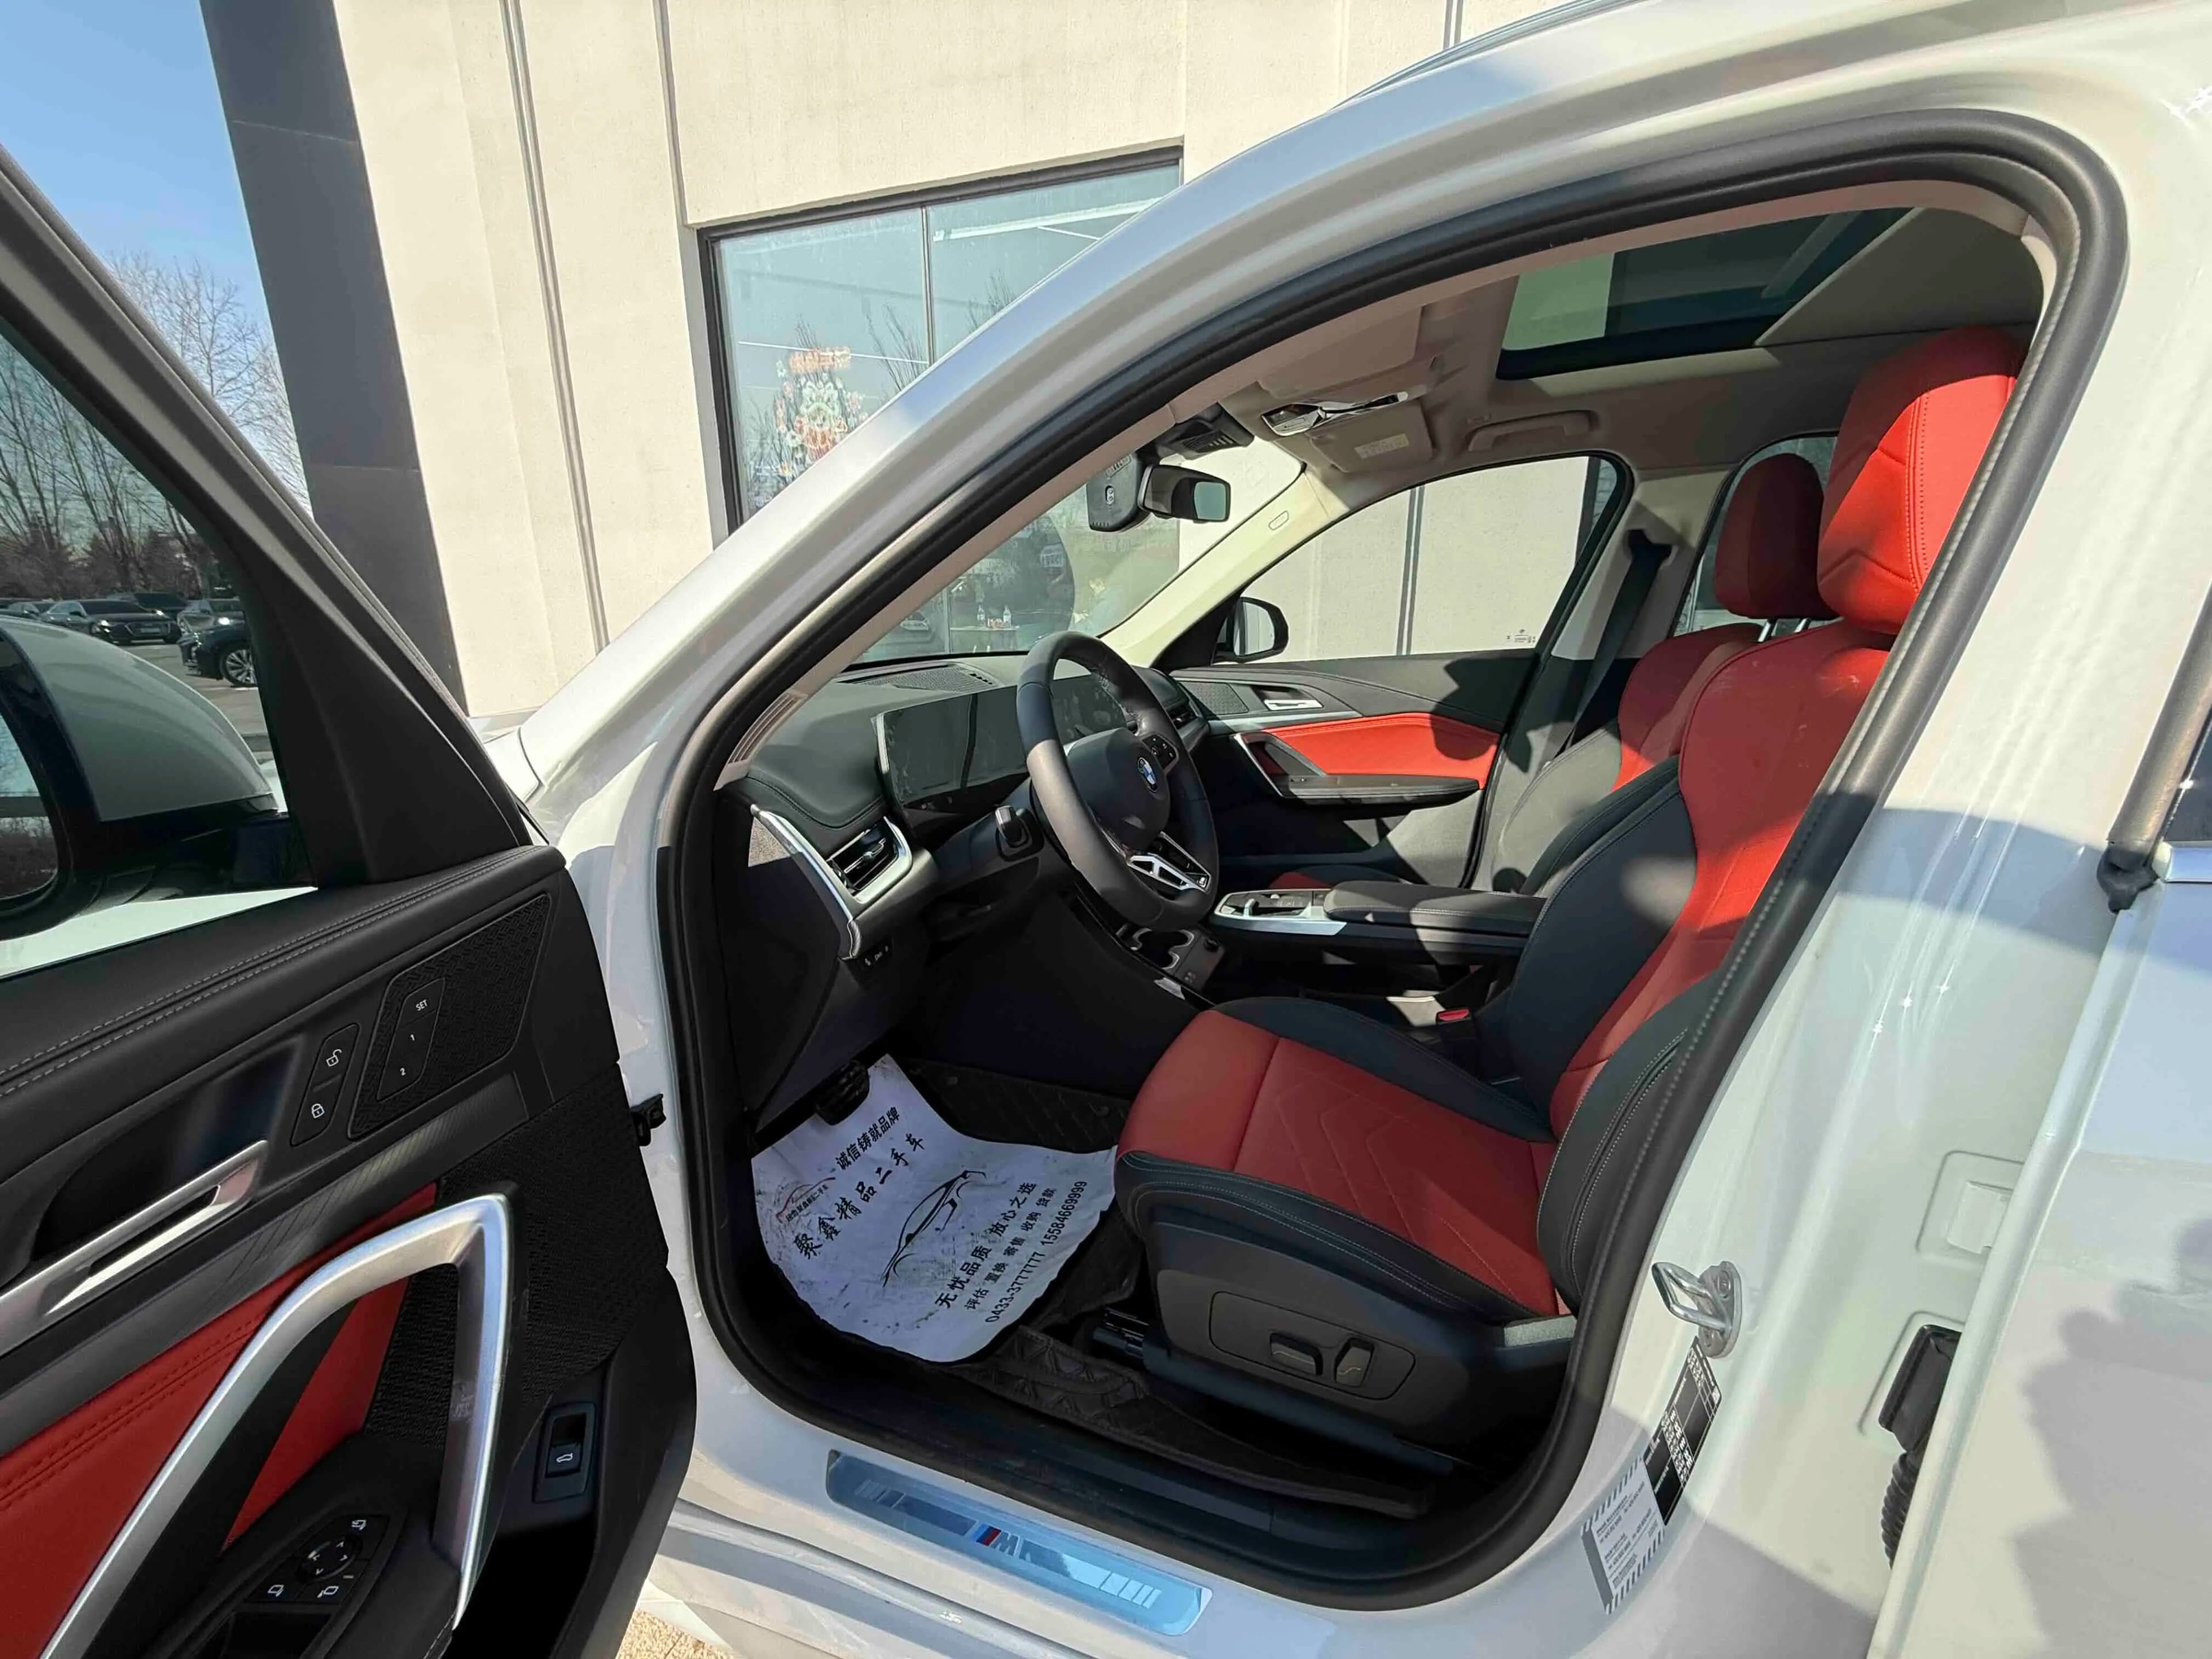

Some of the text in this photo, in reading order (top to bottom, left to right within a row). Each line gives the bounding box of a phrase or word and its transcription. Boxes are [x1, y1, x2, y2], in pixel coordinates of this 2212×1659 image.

[415, 999, 427, 1011] SET
[400, 1067, 406, 1076] 2
[793, 1133, 925, 1260] 聚鑫精品二手车
[835, 1107, 900, 1170] 诚信铸就品牌
[934, 1181, 1037, 1309] 无忧品质 放心之选
[964, 1188, 1057, 1310] 评估 置换 寄售 收购 贷款
[984, 1180, 1088, 1323] 0433-3777777 15584669999
